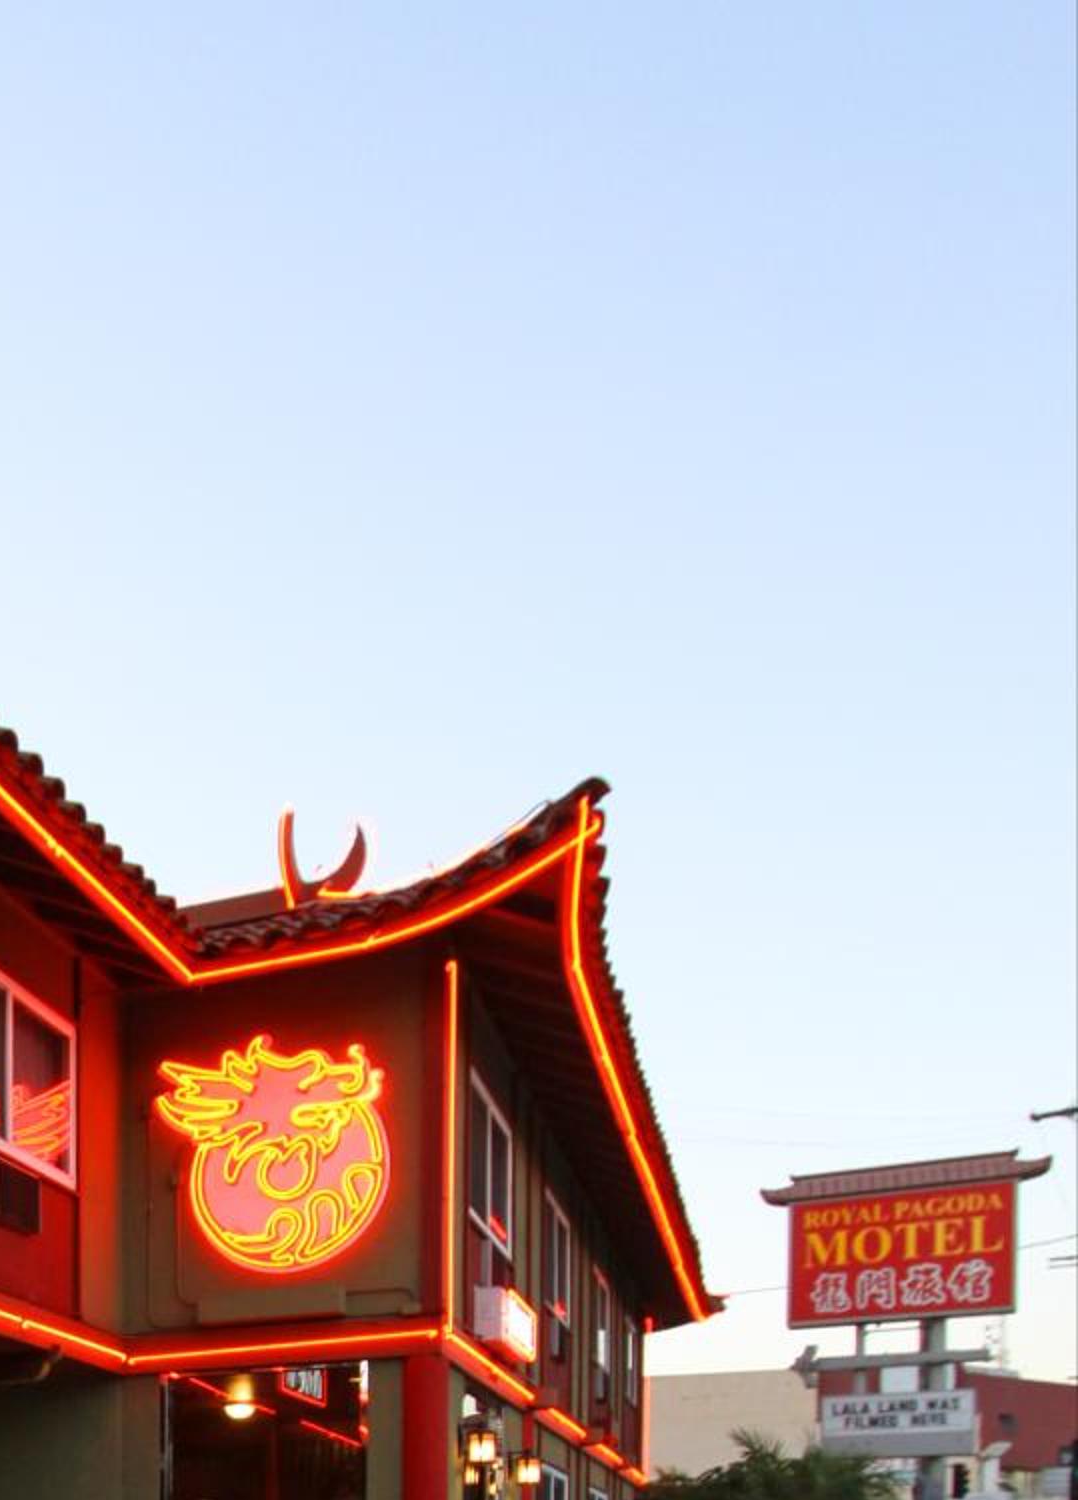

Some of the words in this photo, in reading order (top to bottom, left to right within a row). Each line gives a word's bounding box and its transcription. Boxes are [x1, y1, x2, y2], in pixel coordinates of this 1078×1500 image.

[803, 1202, 890, 1230] ROYAL
[894, 1192, 1003, 1220] PAGODA
[804, 1215, 1004, 1269] MOTEL
[877, 1398, 918, 1413] LAND
